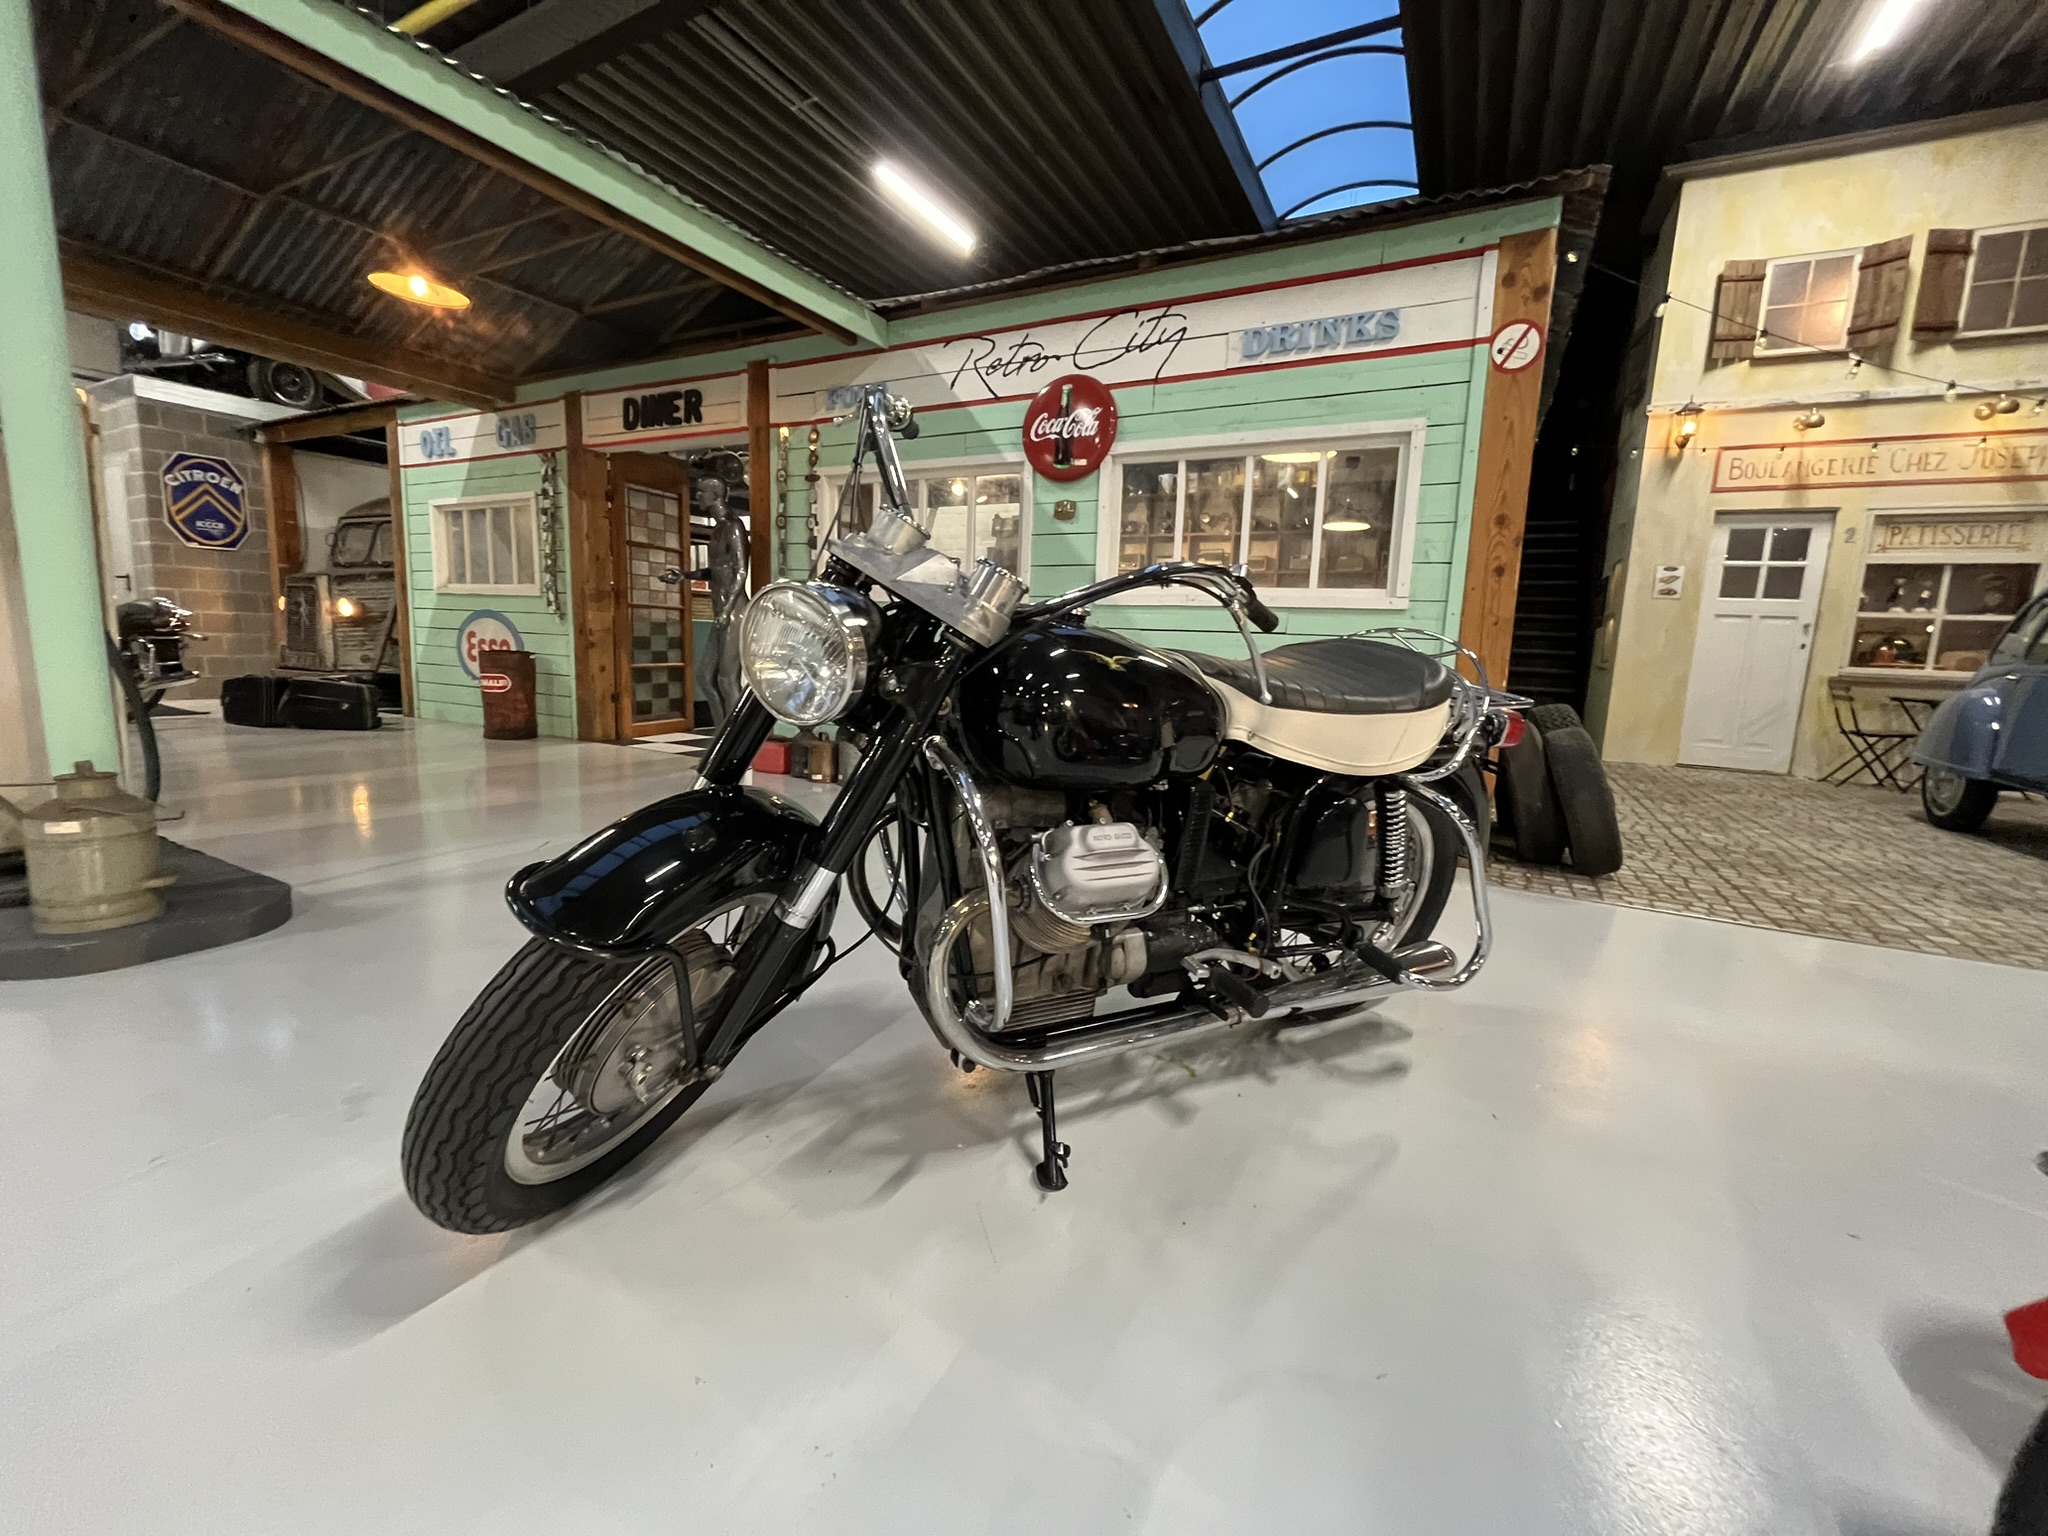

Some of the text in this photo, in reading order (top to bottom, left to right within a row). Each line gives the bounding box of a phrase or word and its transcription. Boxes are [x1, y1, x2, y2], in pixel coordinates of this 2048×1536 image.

[943, 305, 1187, 400] Retro City
[1241, 308, 1400, 358] DRINKS
[622, 388, 703, 431] DINER
[1029, 407, 1103, 442] Coca-Cola
[420, 413, 537, 459] OIL GAS
[1889, 447, 1948, 473] CHEZ
[1844, 526, 1857, 544] 2
